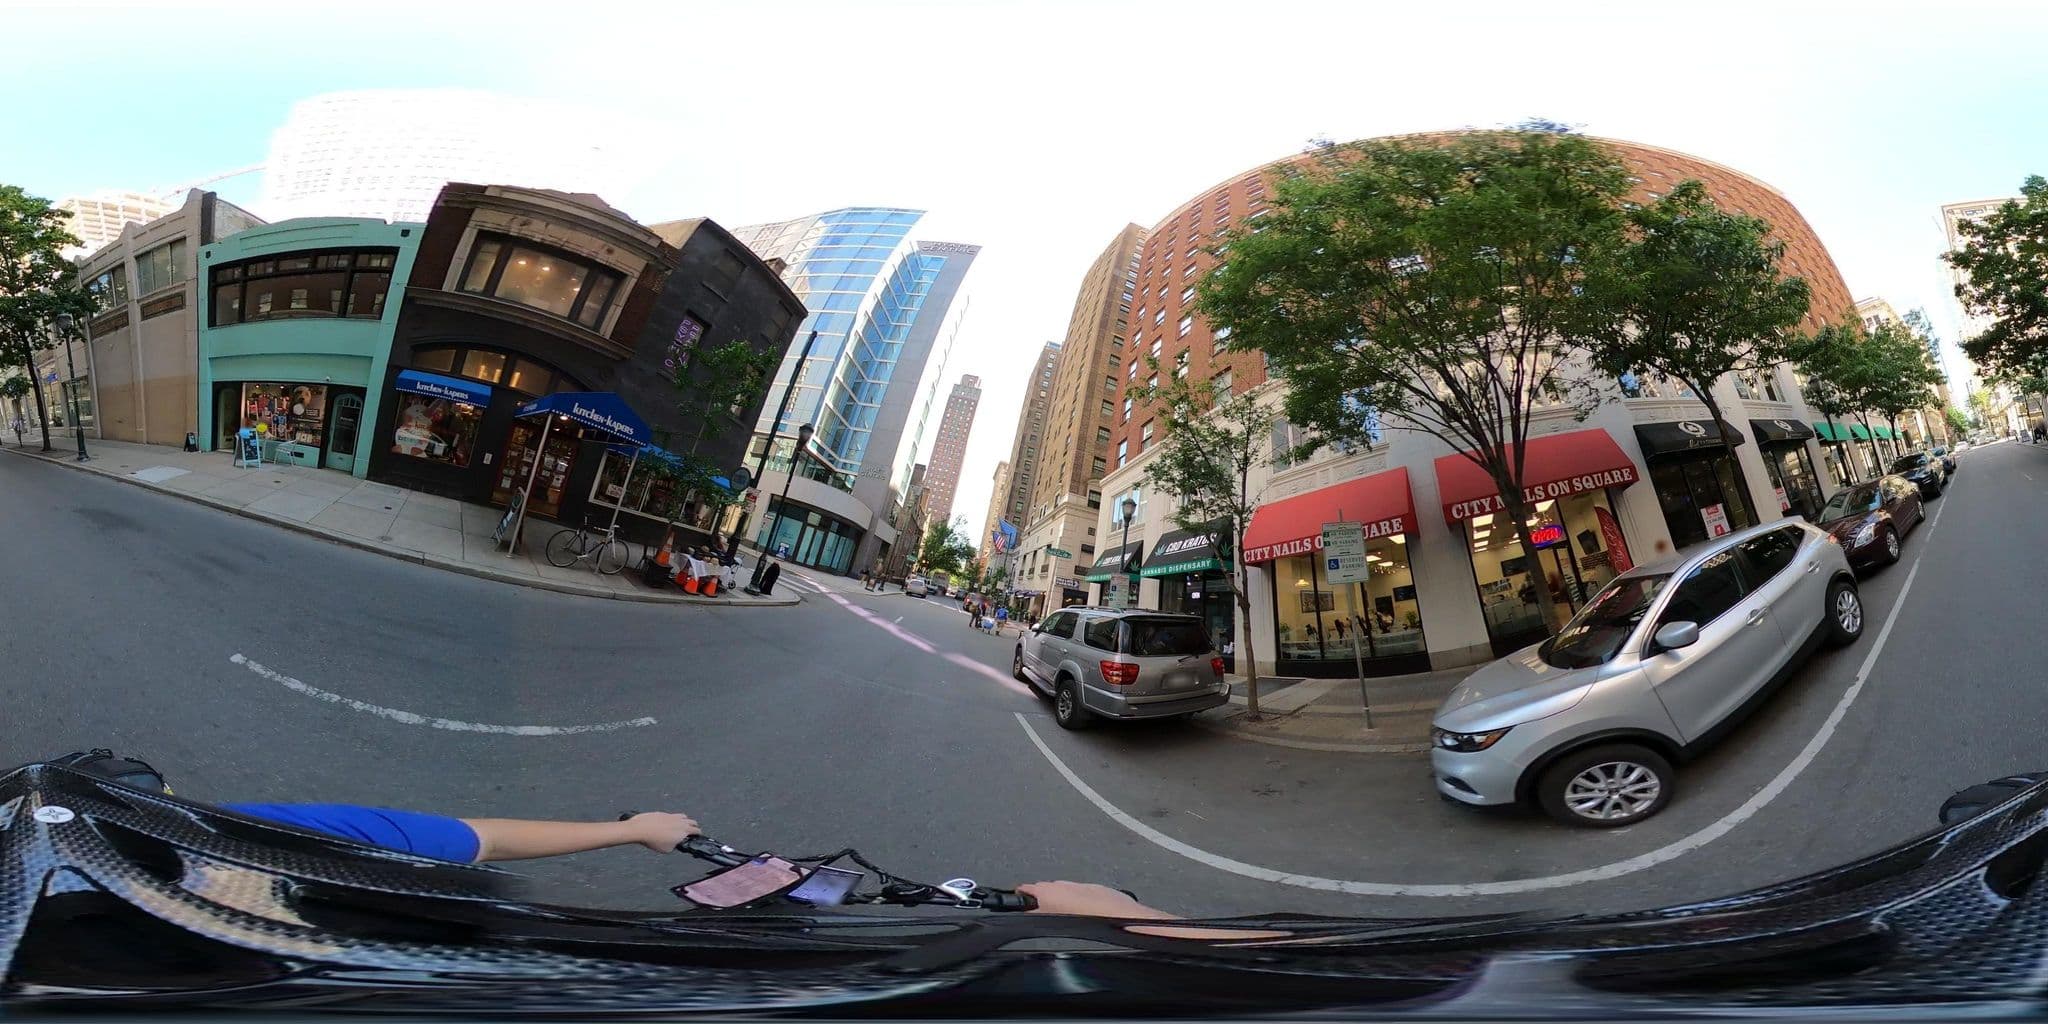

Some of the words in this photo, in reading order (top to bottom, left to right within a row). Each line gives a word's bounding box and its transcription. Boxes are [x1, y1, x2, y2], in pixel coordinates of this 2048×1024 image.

[1451, 497, 1492, 519] CITY
[1494, 484, 1546, 510] NLS
[1547, 480, 1570, 497] ON
[1572, 468, 1633, 492] SQUARE
[1243, 546, 1271, 562] CITY
[1272, 538, 1312, 558] NAILS
[1168, 560, 1212, 575] DISPENSARY
